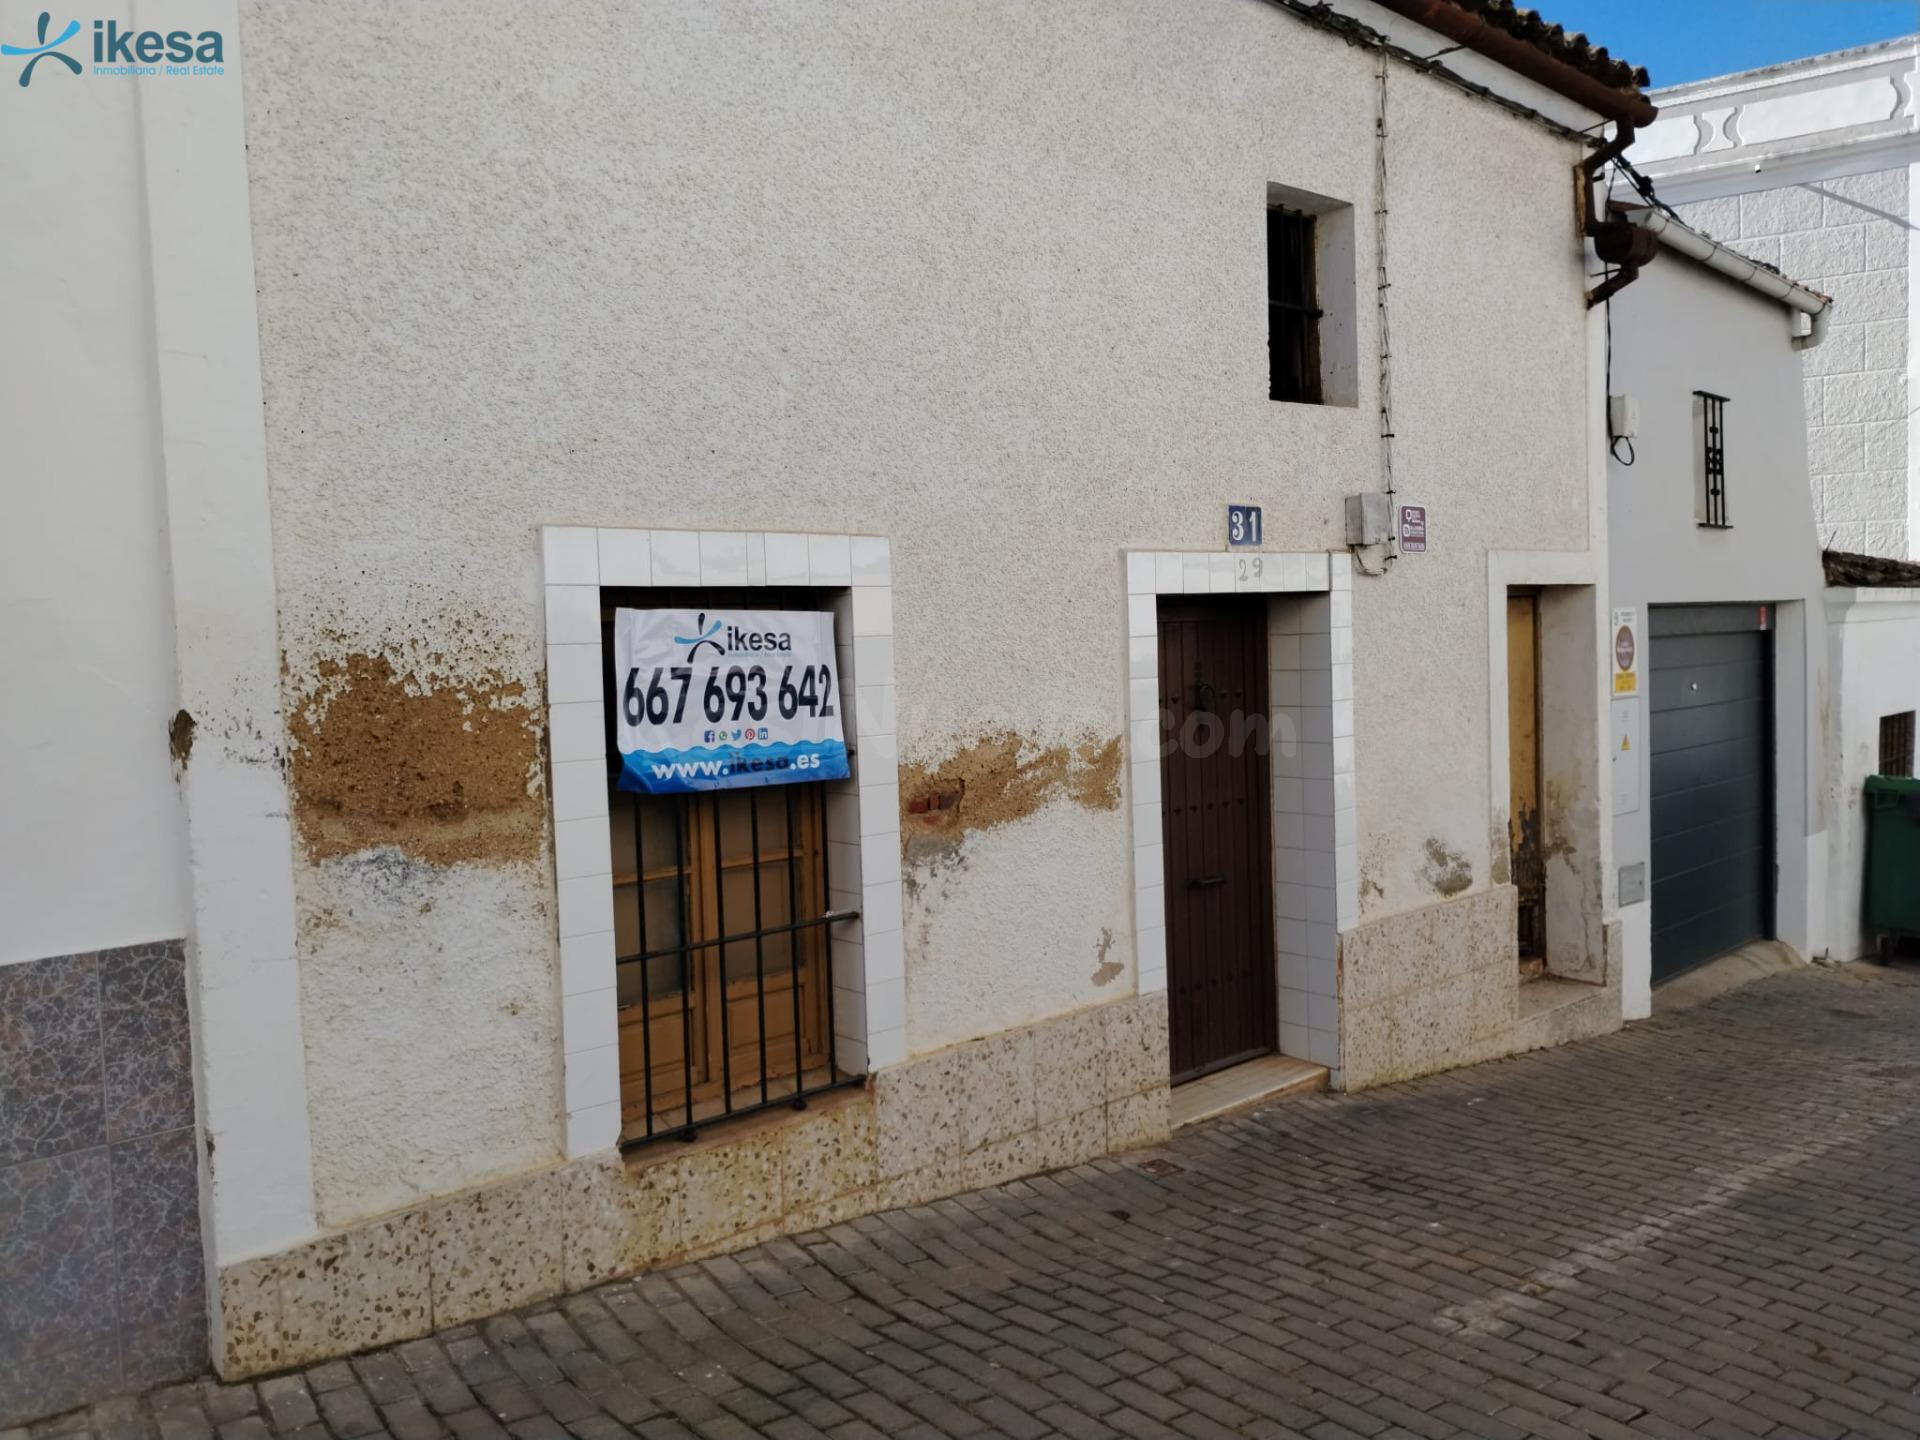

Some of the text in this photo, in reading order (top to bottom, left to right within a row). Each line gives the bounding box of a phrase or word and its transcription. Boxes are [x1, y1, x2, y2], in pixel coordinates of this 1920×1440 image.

[1231, 510, 1258, 542] 31
[1238, 556, 1263, 582] 29
[726, 626, 792, 652] ikesa
[623, 667, 693, 727] 667
[703, 665, 768, 723] 693
[778, 664, 834, 720] 642
[651, 752, 820, 779] www.ikesa.es
